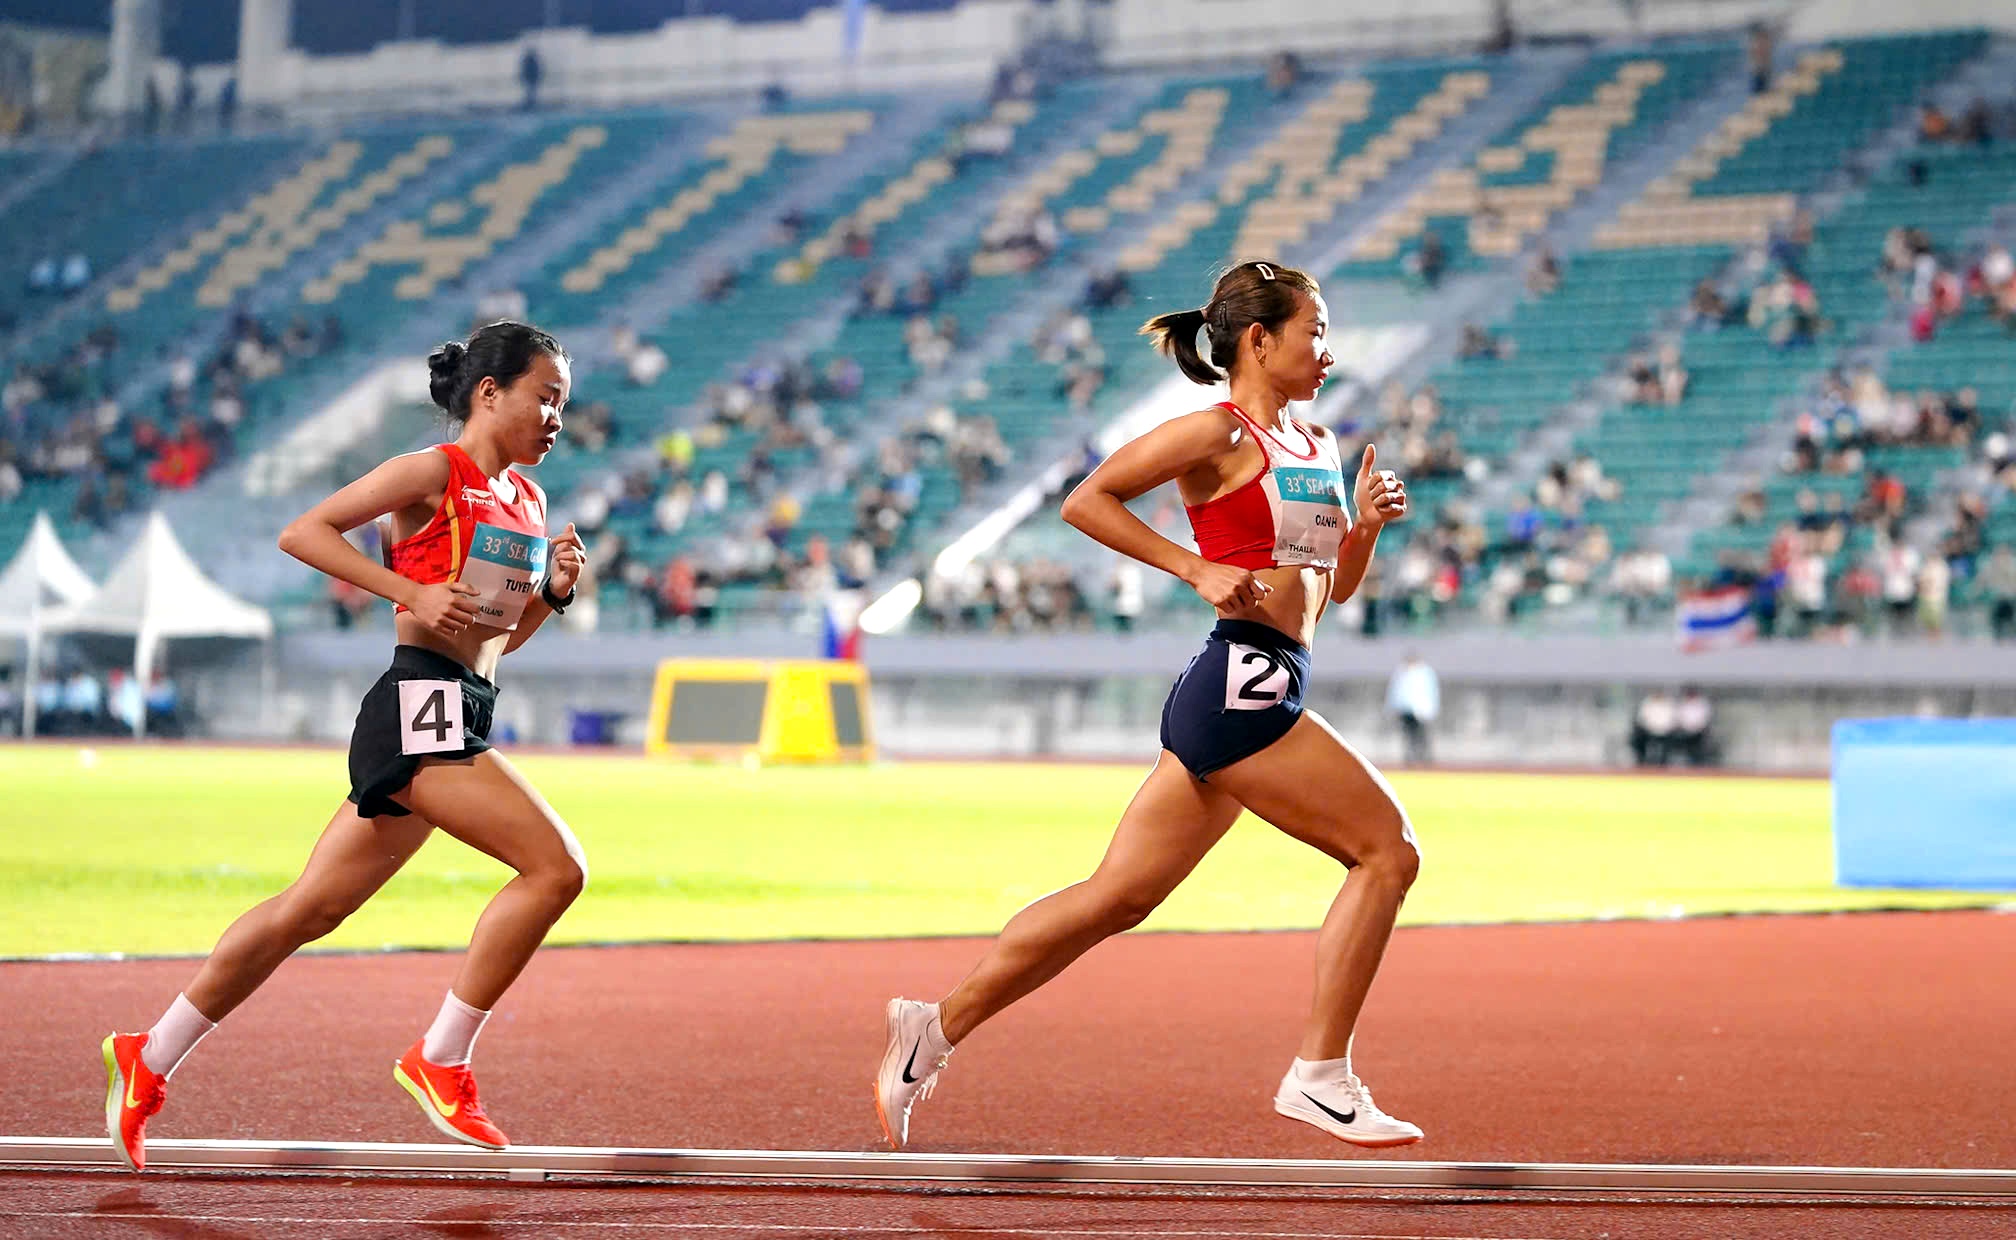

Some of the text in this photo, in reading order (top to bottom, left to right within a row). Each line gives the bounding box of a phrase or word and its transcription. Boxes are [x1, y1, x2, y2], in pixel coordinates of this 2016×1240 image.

[107, 49, 1844, 311] NATIONAL
[1306, 478, 1325, 495] SEA
[1315, 514, 1337, 528] OANH
[507, 542, 529, 561] SEA
[505, 578, 532, 593] TUYET
[480, 605, 504, 617] AILAND
[1238, 652, 1279, 701] 2
[411, 689, 453, 742] 4
